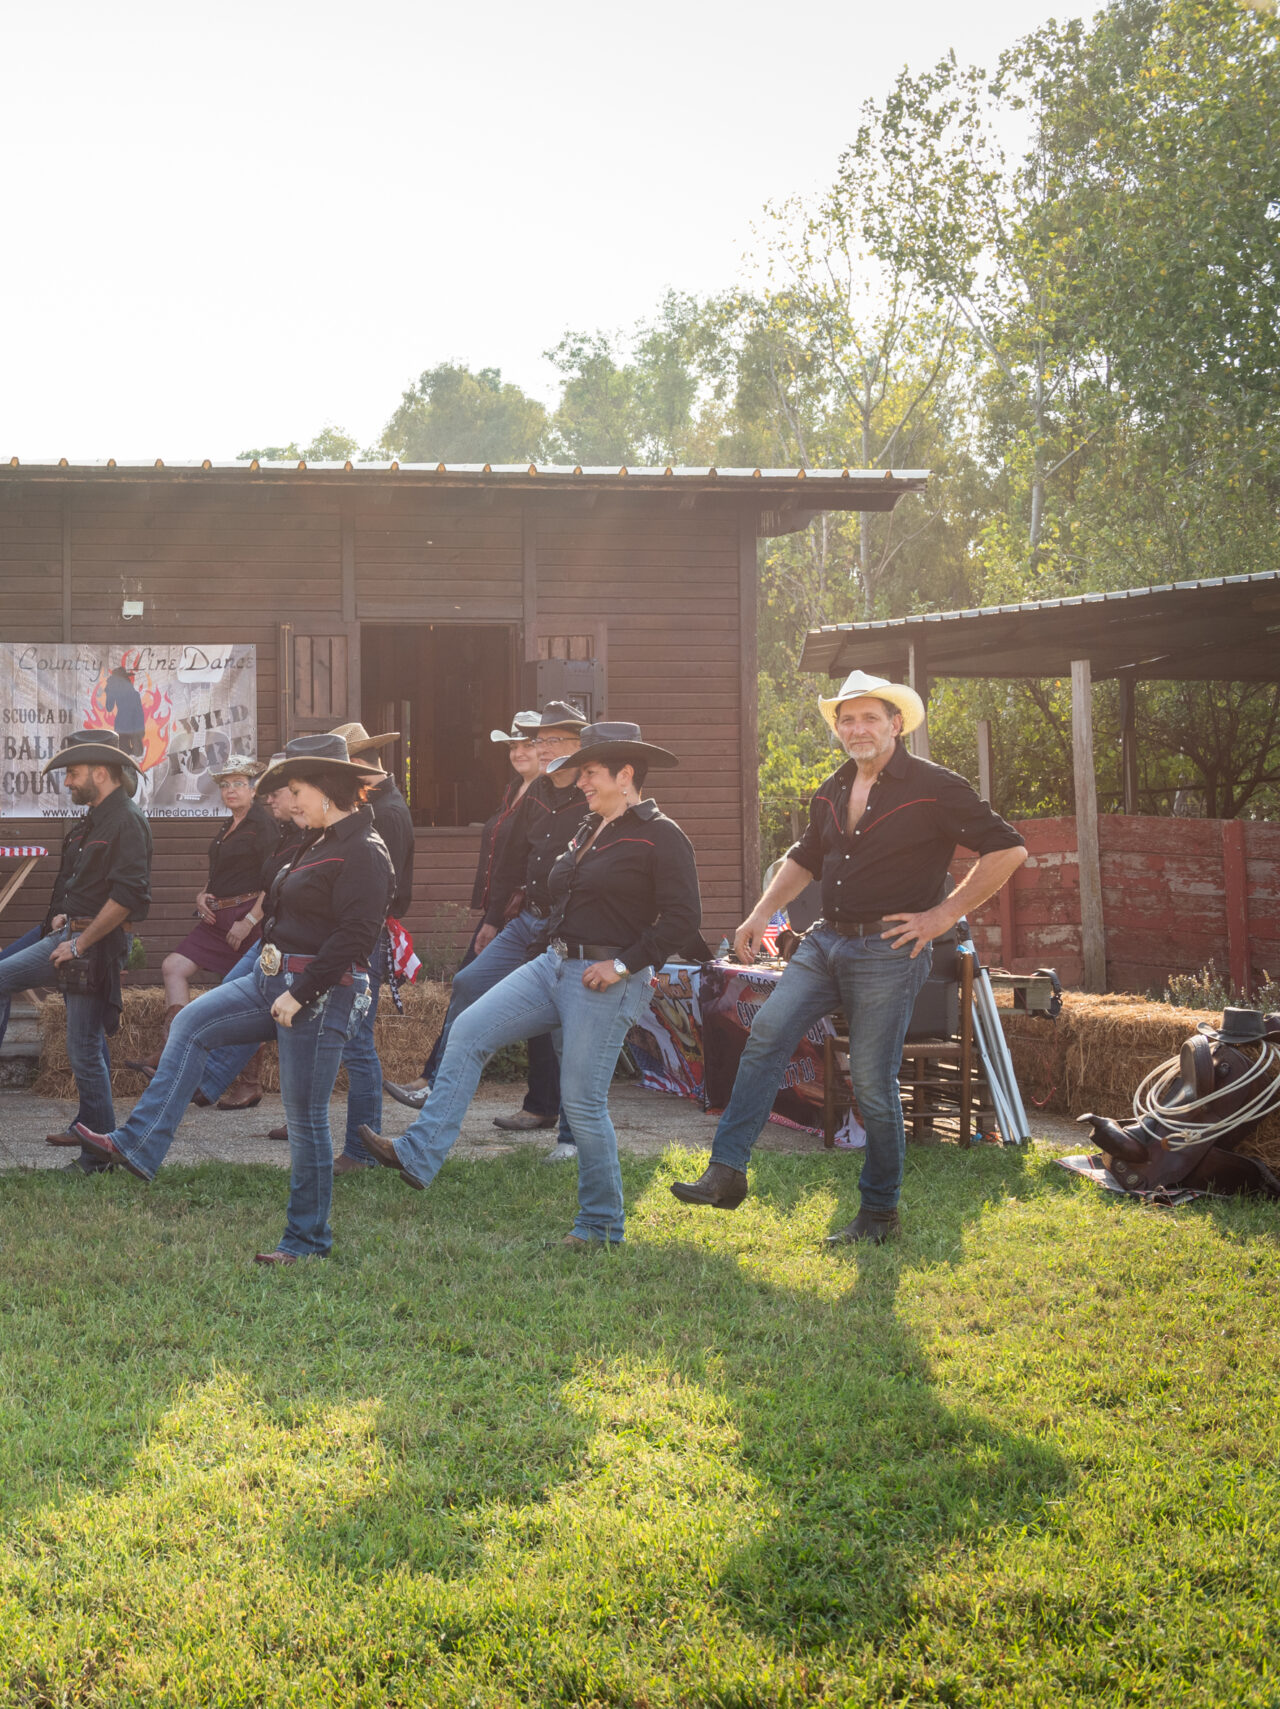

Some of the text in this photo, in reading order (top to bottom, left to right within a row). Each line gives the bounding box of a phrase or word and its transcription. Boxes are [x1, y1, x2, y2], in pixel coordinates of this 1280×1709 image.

[19, 647, 255, 683] Country Line Dance
[2, 708, 73, 724] SCUOLA DI
[179, 704, 249, 735] WILD
[167, 734, 257, 777] FIRE
